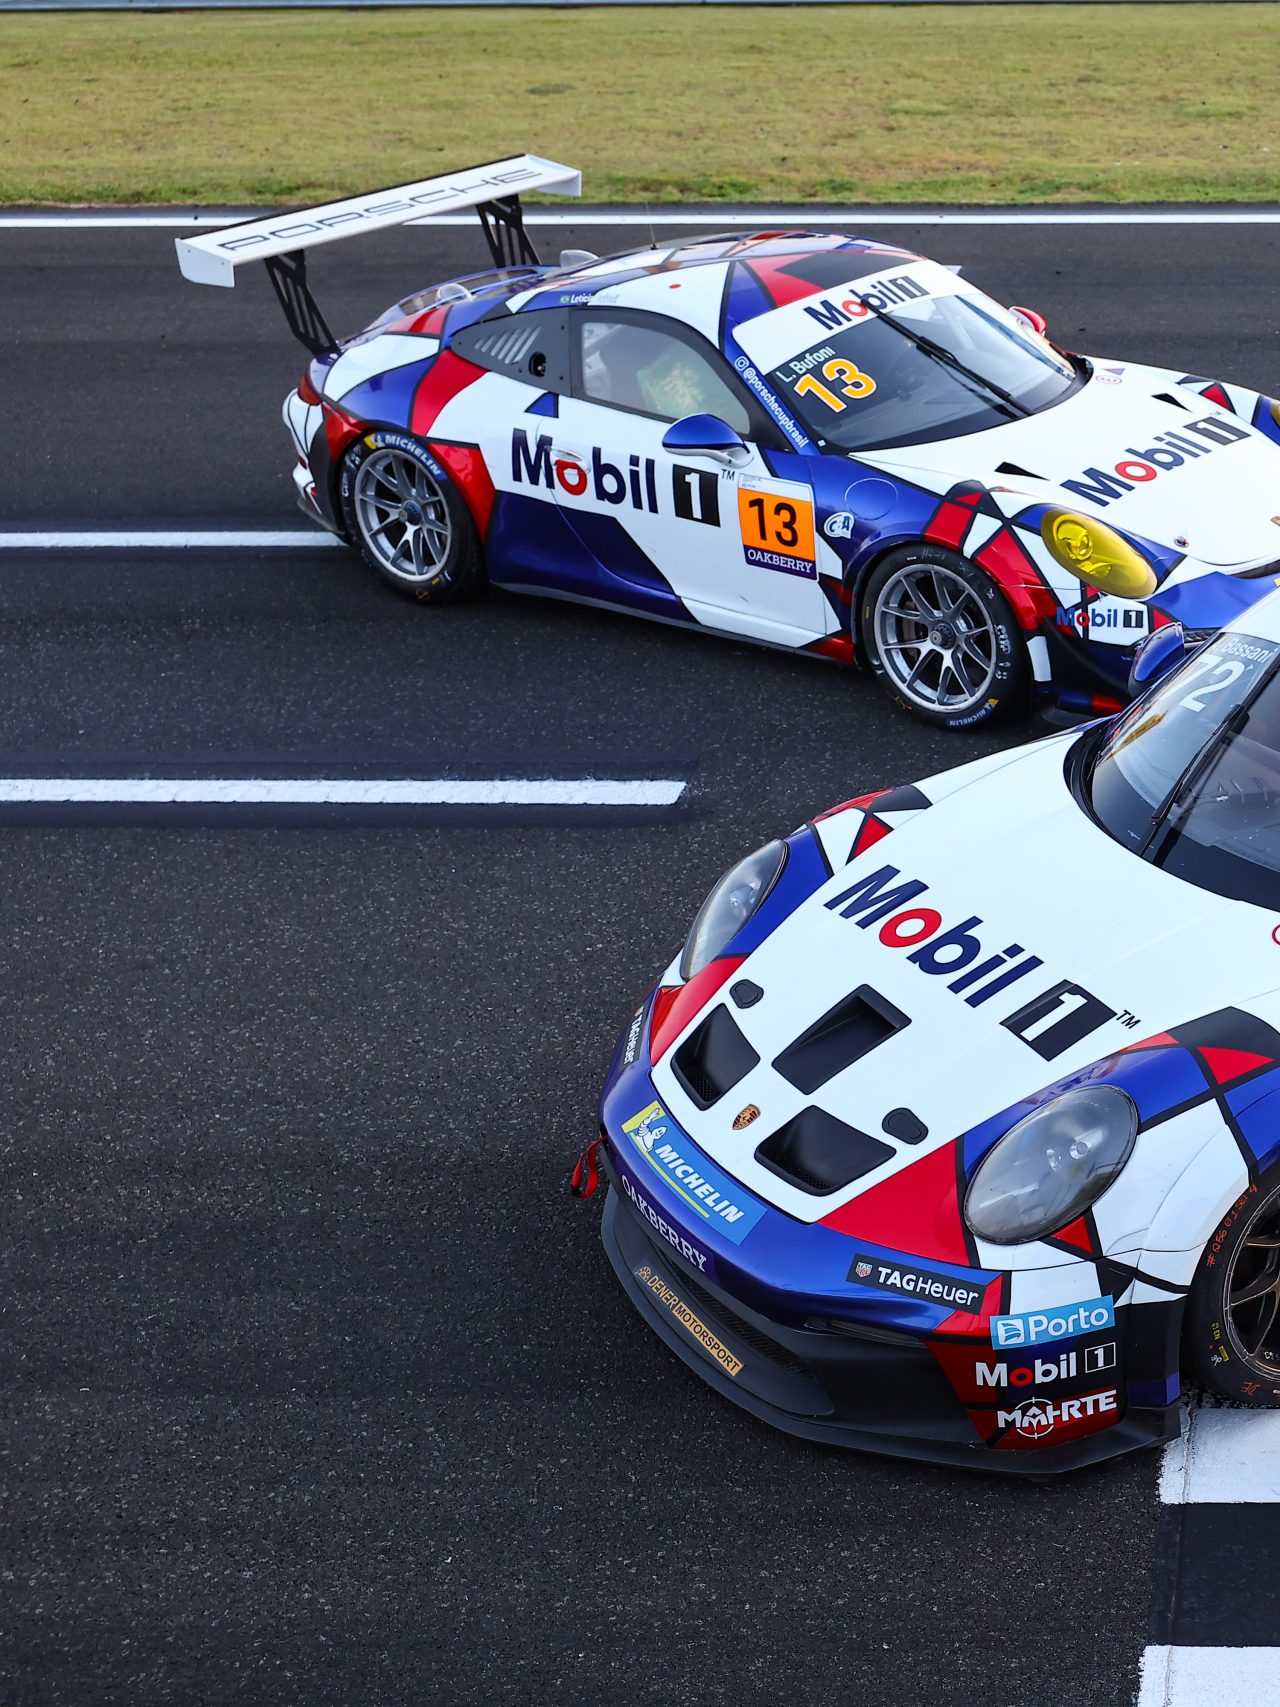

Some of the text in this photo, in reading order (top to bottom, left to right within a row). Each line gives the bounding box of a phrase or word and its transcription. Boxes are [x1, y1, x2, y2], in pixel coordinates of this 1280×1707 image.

[218, 168, 542, 251] PORSCHE
[803, 279, 897, 330] Mobil
[776, 346, 835, 383] L. Bufoni
[794, 358, 877, 413] 13
[743, 367, 809, 448] @porschecupbrasil
[385, 435, 442, 476] MICHELIN
[512, 428, 735, 520] Mobil 1 TM
[1059, 432, 1212, 507] Mobil
[1194, 419, 1234, 443] 1
[749, 498, 799, 548] 13
[747, 549, 812, 573] OAKBERRY
[1056, 607, 1118, 628] Mobil
[1159, 653, 1246, 713] 72
[823, 864, 1142, 1042] Mobil 1 TM
[654, 1143, 745, 1224] MICHELIN
[621, 1175, 707, 1273] OAKBERRY
[647, 1276, 741, 1372] DENER MOTORSPORT
[1028, 1307, 1109, 1341] Porto
[976, 1352, 1077, 1387] Mobil
